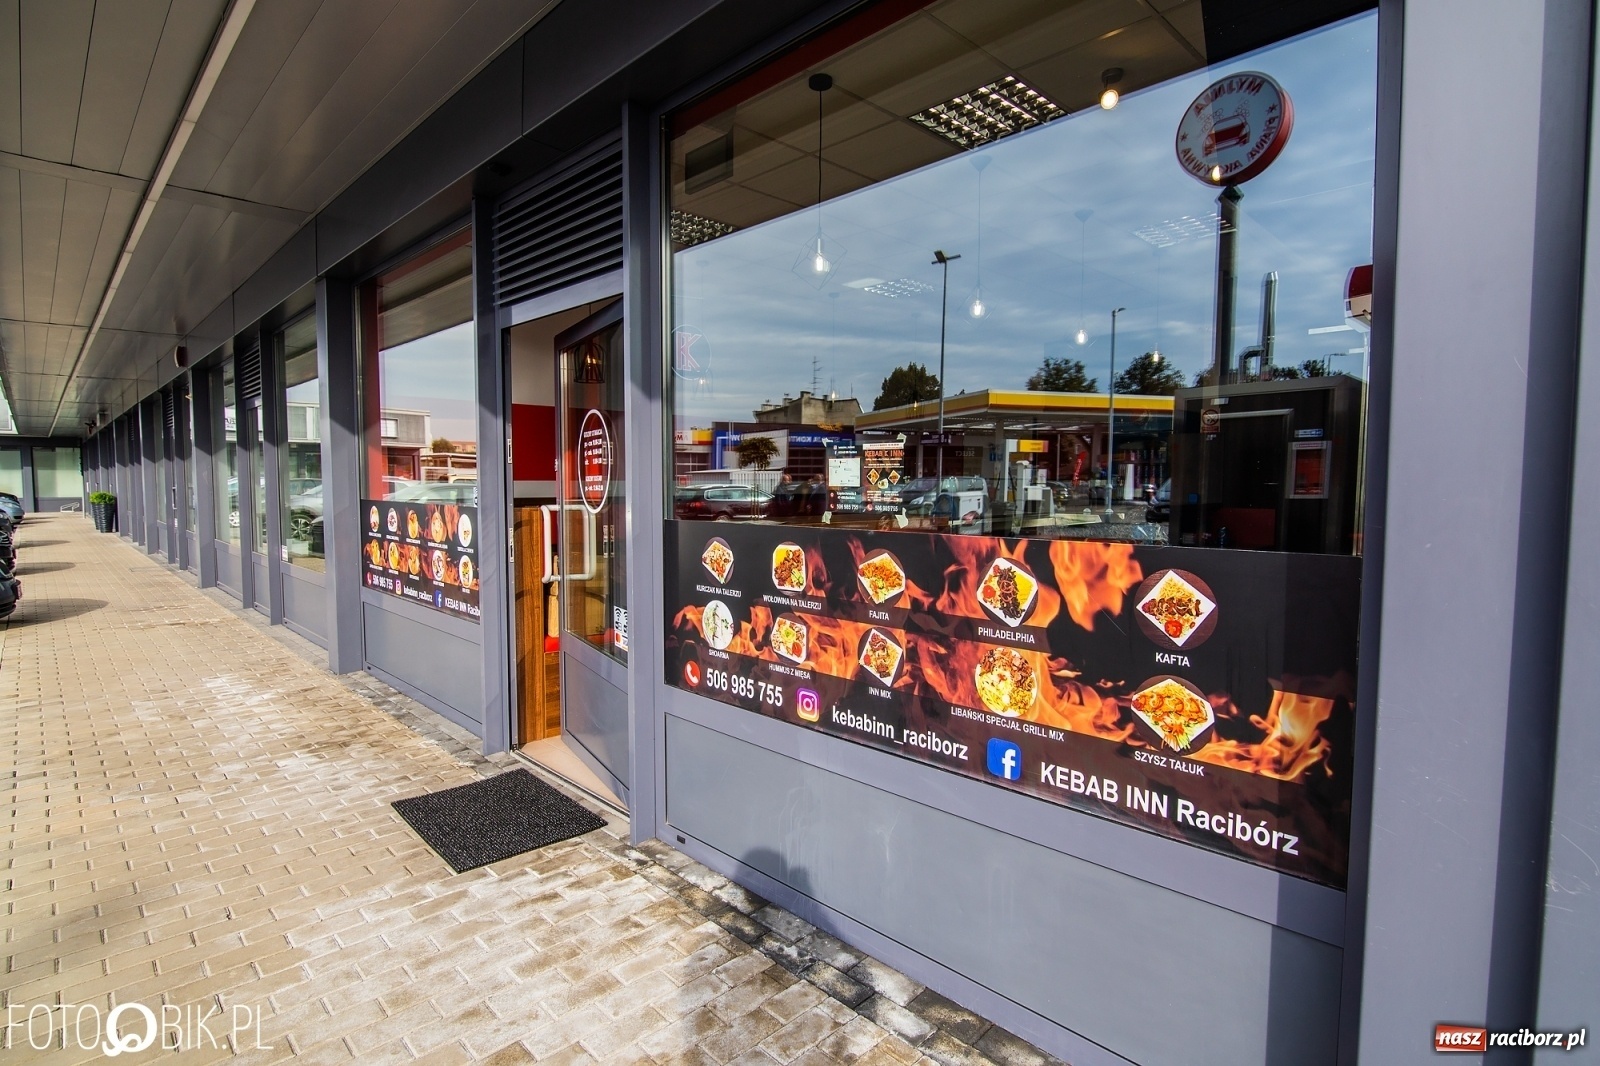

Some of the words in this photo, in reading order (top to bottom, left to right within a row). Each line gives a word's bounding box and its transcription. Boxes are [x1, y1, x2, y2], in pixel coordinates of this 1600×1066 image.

[716, 587, 722, 595] NA
[722, 588, 742, 598] TALERZU
[763, 594, 790, 606] WOŁOWINA
[790, 598, 798, 607] NA
[798, 599, 822, 610] TALERZU
[869, 610, 890, 621] FAJITA
[978, 626, 1035, 644] PHILADELPHIA
[1155, 652, 1190, 667] KAFTA
[768, 663, 790, 675] HUMMUS
[790, 668, 794, 676] Z
[706, 668, 728, 692] 506
[731, 674, 755, 699] 985
[758, 681, 783, 707] 755
[869, 687, 879, 697] INN
[880, 688, 892, 700] MIX
[832, 704, 969, 761] kebabinn_raciborz
[951, 706, 985, 723] LIBAŃSKI
[985, 714, 1021, 731] SPECJAŁ
[1022, 723, 1047, 738] GRILL
[1048, 729, 1064, 742] MIX
[1134, 750, 1167, 767] SZYSZ
[1169, 758, 1205, 777] TAŁUK
[1040, 761, 1119, 803] KEBAB
[1126, 784, 1168, 818] INN
[1176, 799, 1299, 856] Racibórz
